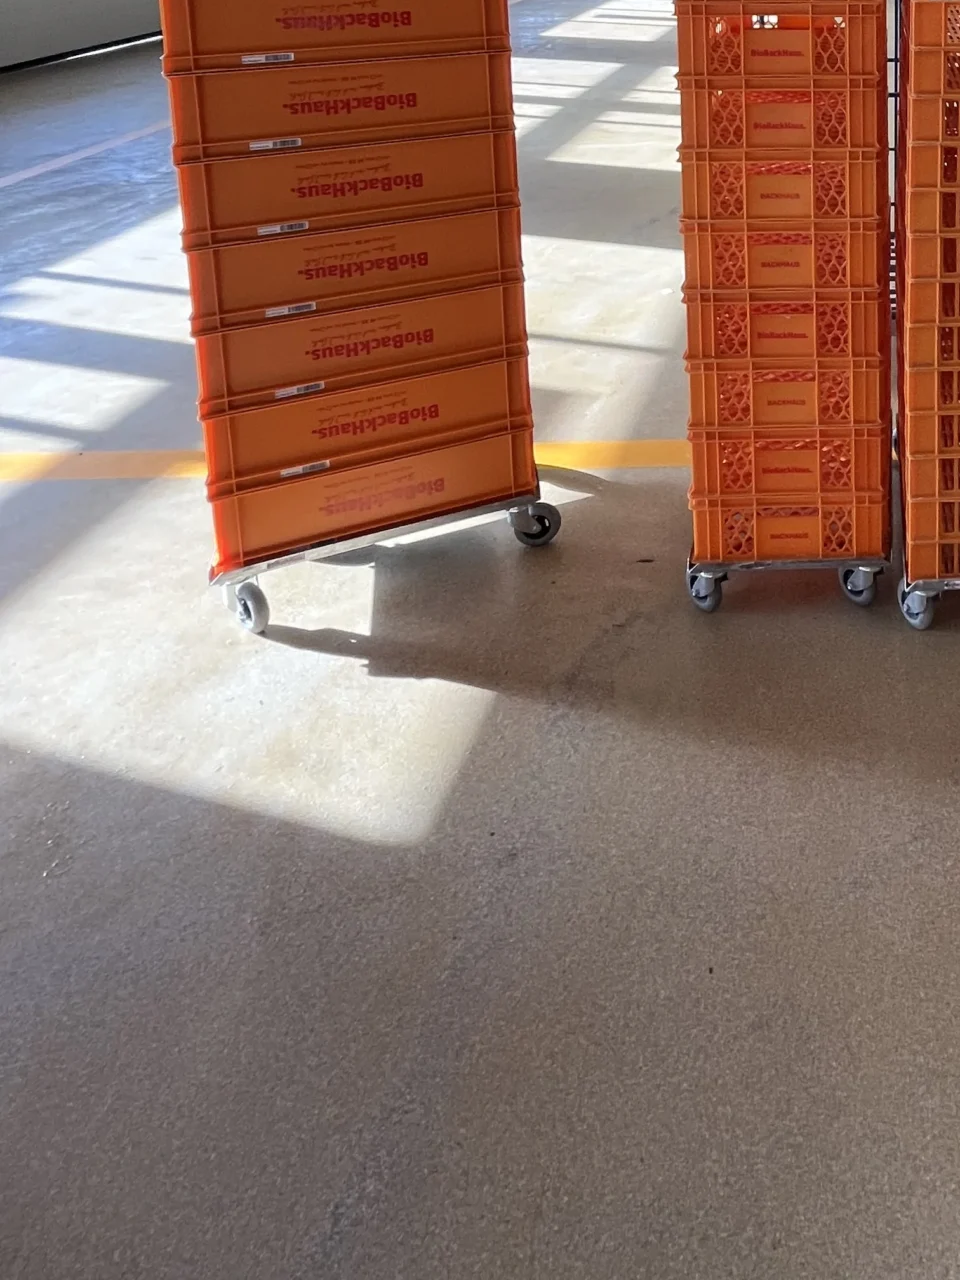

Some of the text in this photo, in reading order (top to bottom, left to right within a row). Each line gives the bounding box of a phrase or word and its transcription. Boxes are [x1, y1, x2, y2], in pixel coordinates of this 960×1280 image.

[282, 93, 416, 116] BioBackHaus.
[290, 173, 423, 199] BioBackHaus.
[298, 252, 428, 280] BioBackHaus.
[304, 329, 433, 359] BioBackHaus.
[311, 403, 440, 440] BioBackHaus.
